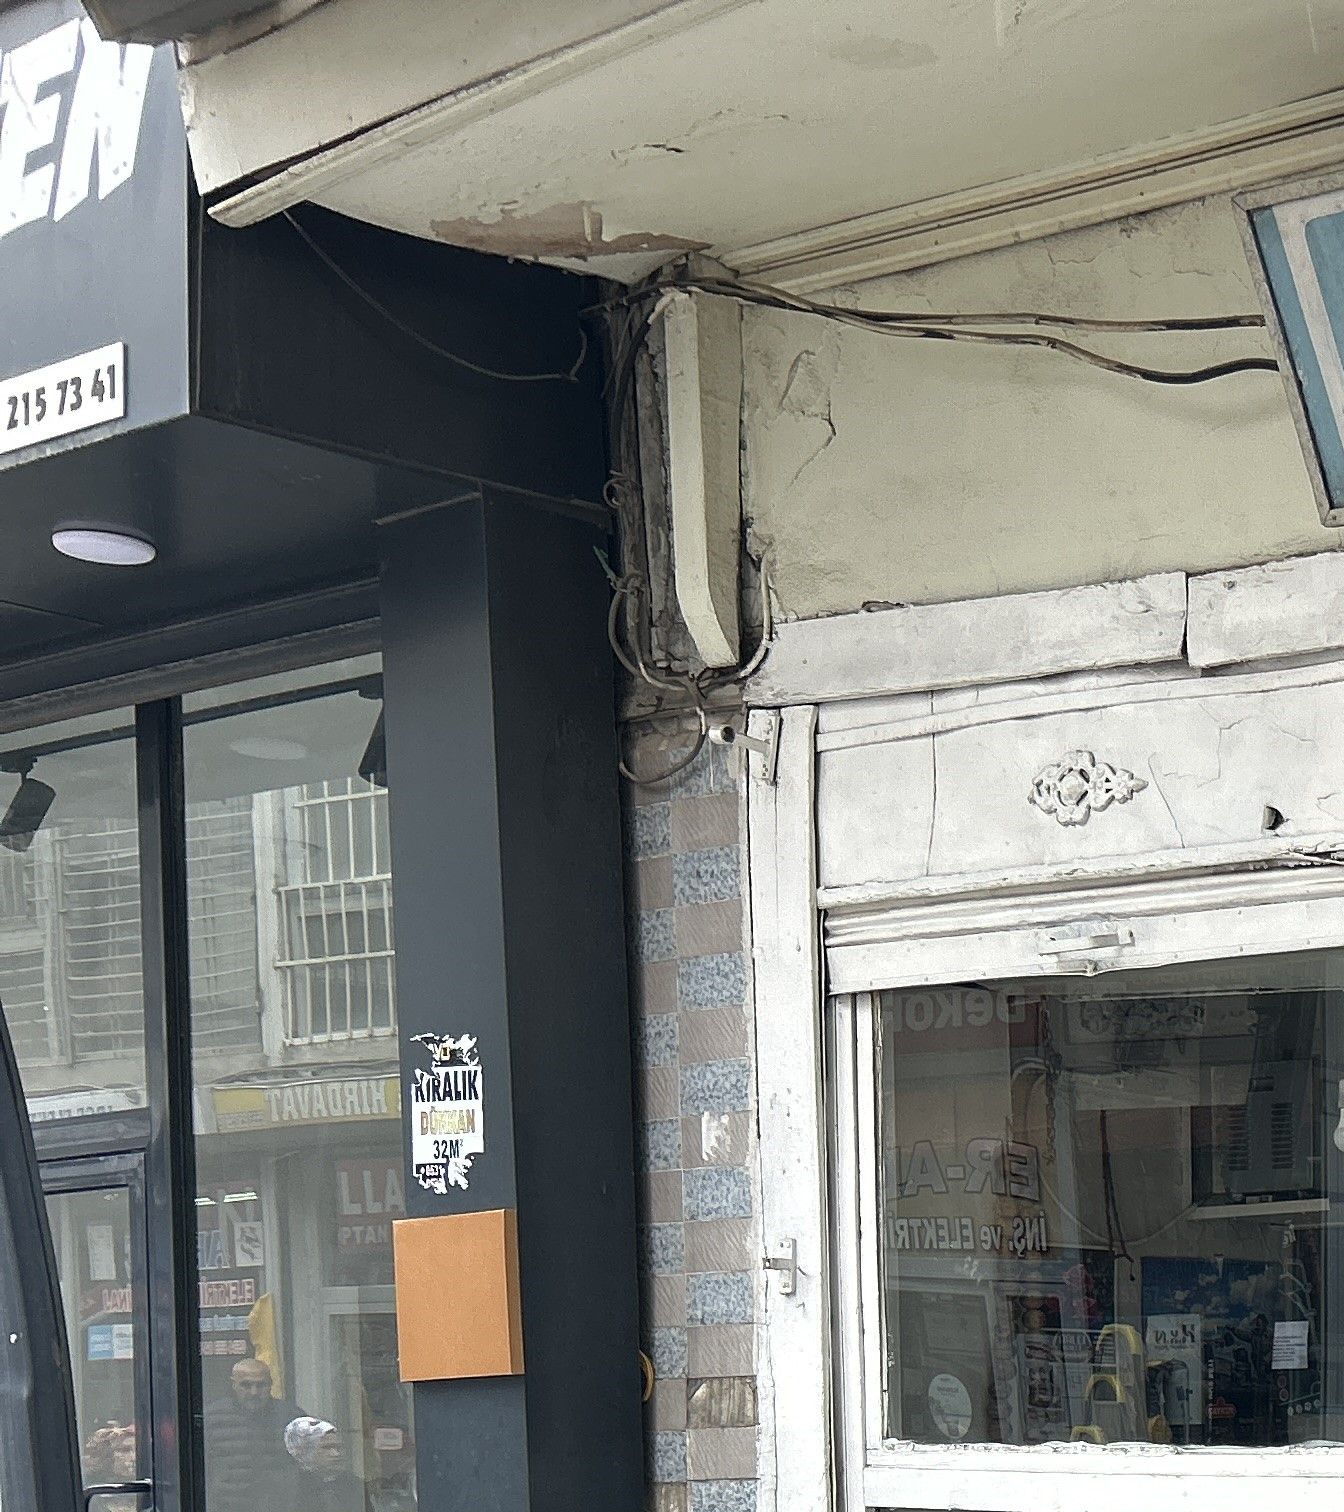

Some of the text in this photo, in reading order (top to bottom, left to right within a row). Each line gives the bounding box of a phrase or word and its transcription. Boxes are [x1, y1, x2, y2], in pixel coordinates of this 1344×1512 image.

[7, 363, 116, 430] 215 73 41
